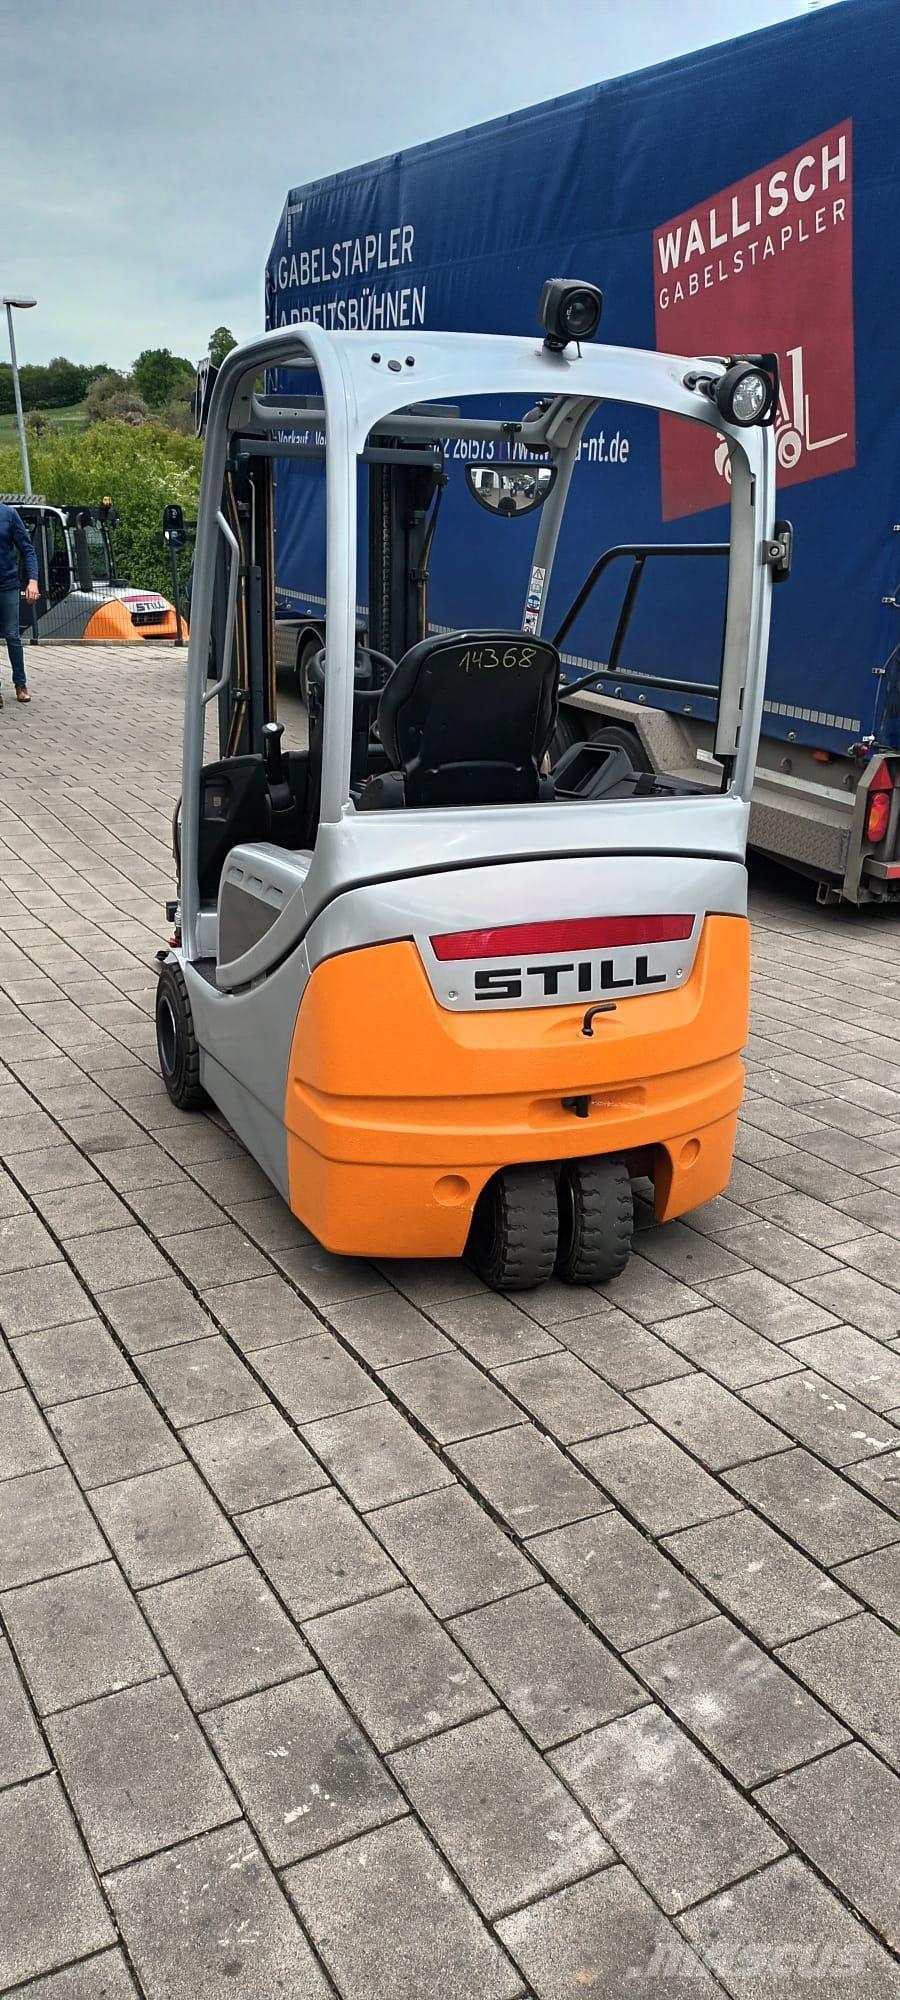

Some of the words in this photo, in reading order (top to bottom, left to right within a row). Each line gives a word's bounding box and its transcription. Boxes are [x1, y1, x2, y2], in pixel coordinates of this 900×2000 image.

[658, 135, 846, 274] WALLISCH
[278, 224, 415, 289] GABELSTAPLER
[659, 198, 846, 309] GABELSTAPLER
[136, 601, 165, 611] STILL
[459, 647, 537, 672] 14368
[474, 956, 667, 1001] STILL
